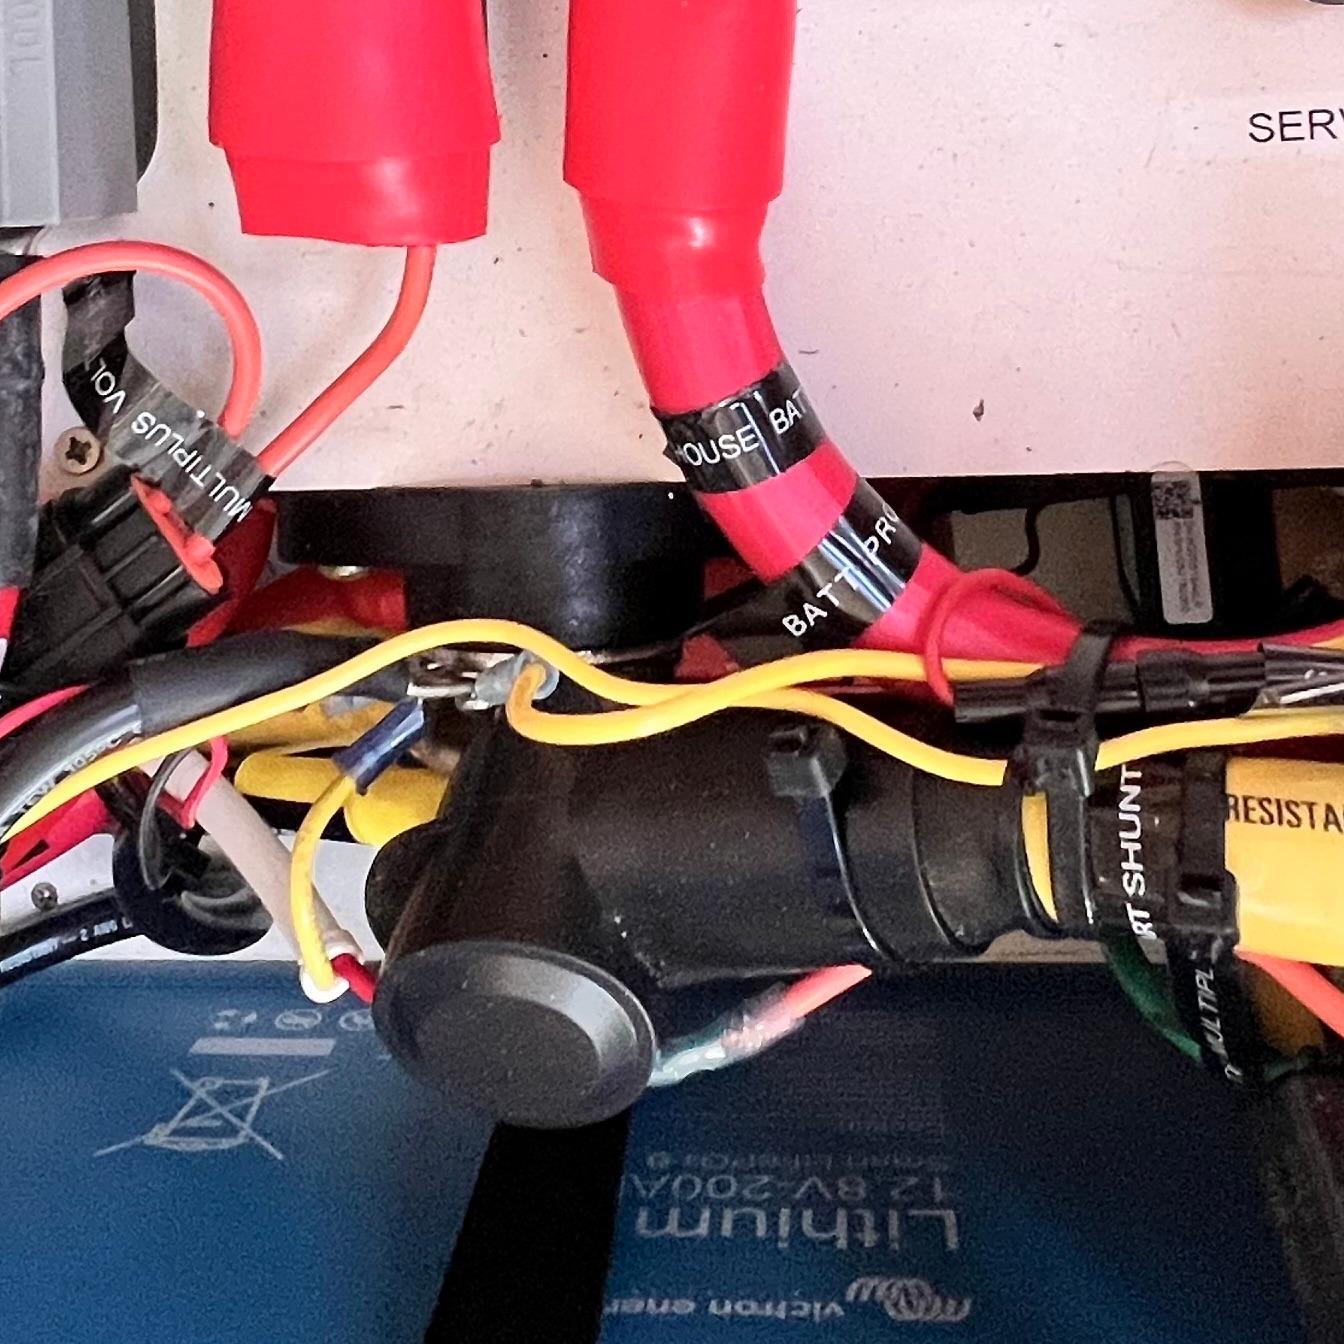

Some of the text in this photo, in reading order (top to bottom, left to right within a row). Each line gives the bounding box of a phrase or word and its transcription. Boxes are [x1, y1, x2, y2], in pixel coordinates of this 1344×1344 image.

[131, 411, 252, 523] MULTIPLUS
[678, 424, 760, 468] OUSE
[782, 567, 858, 638] BATT
[1117, 765, 1147, 896] SHUNT
[633, 1206, 959, 1251] Lithium
